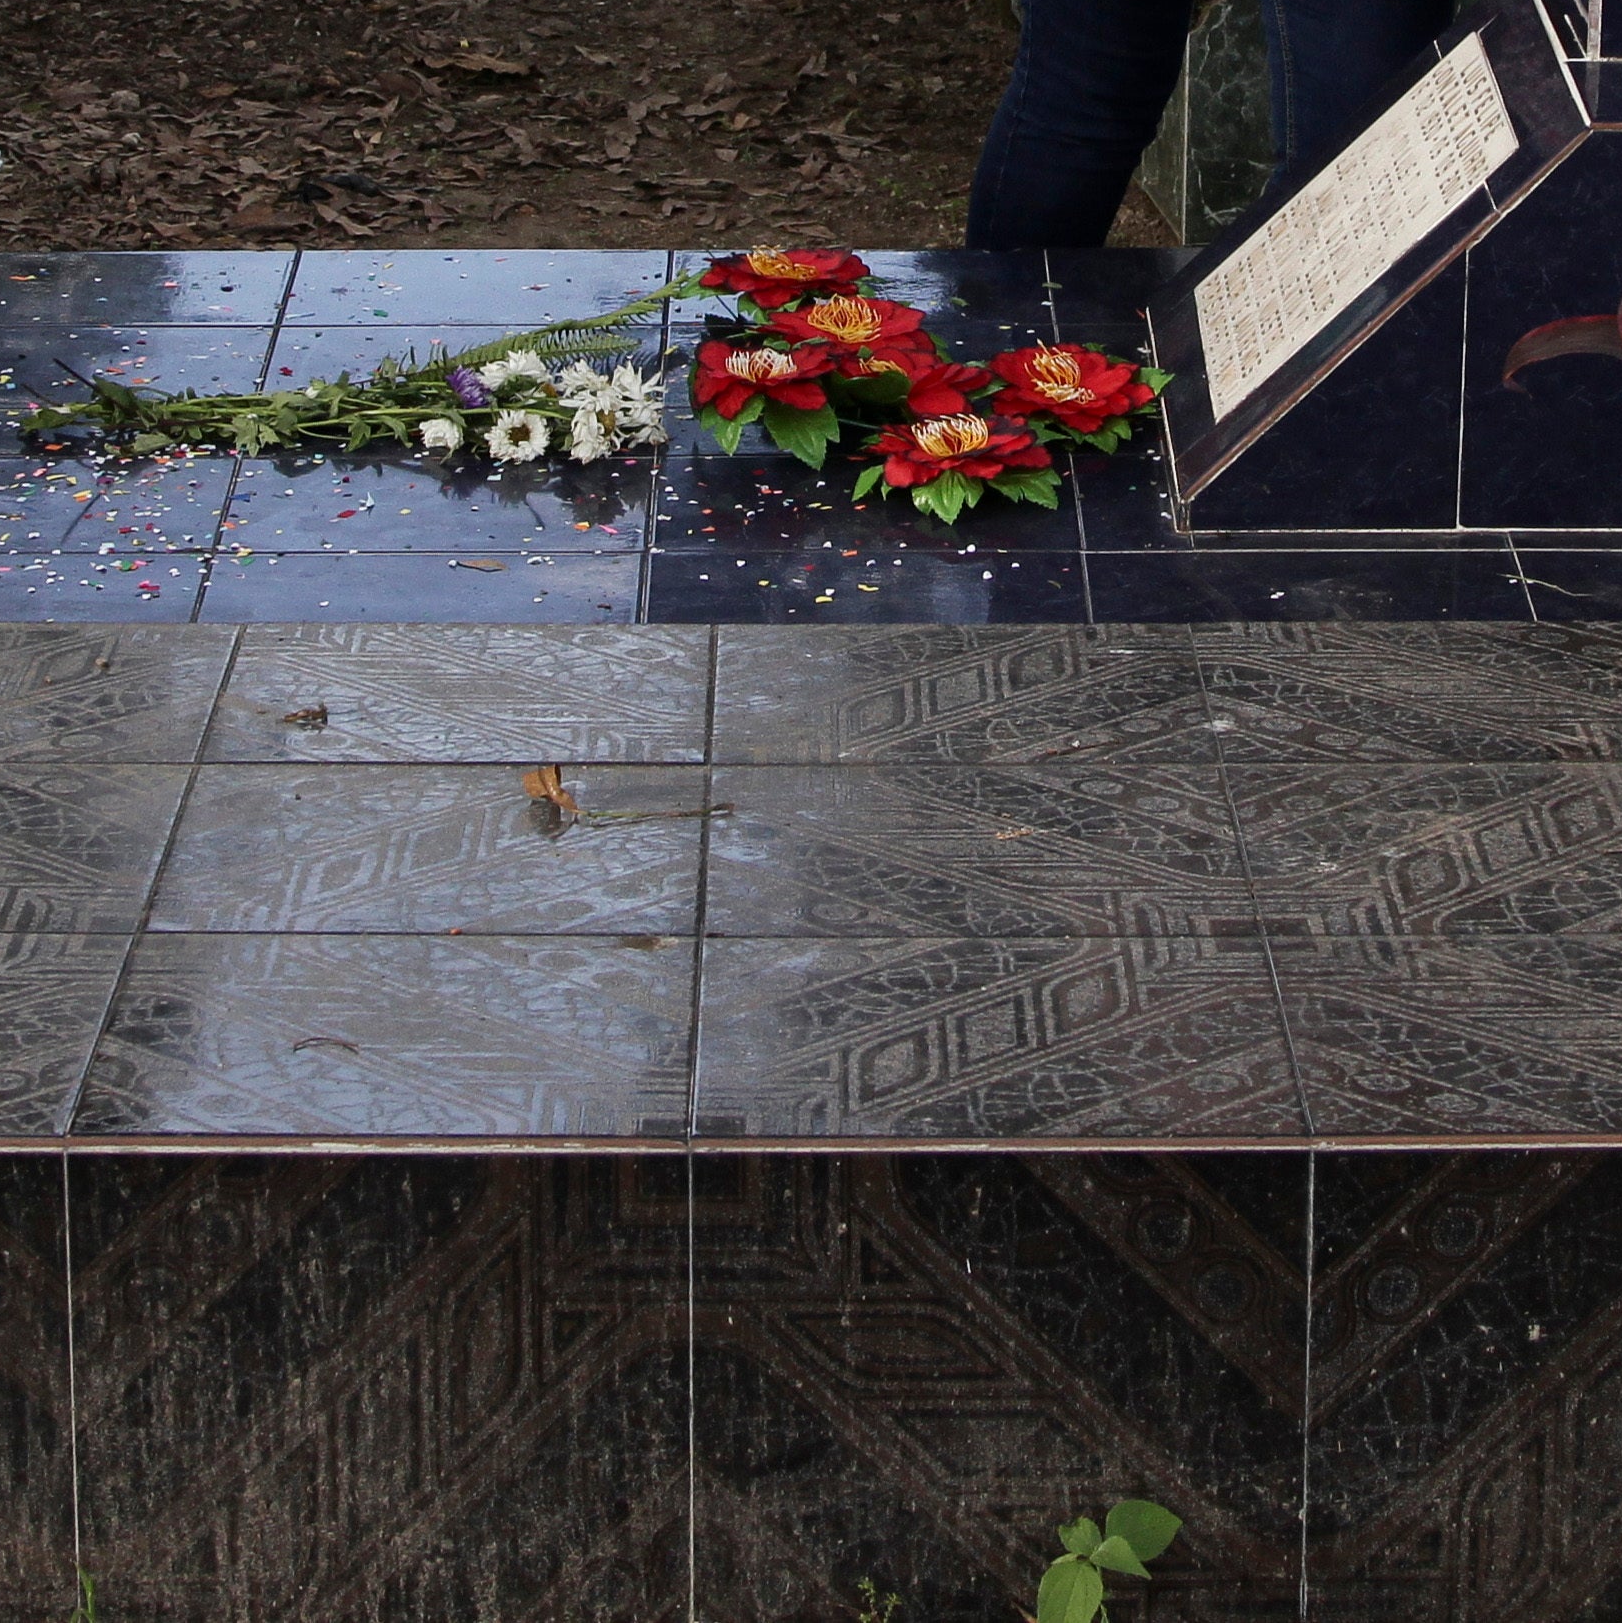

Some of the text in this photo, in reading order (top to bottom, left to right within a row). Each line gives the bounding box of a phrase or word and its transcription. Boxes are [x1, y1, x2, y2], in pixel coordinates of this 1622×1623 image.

[1430, 56, 1489, 188] GONZALEZ AGUIRRE
[1459, 54, 1505, 144] LUIS FELIPE
